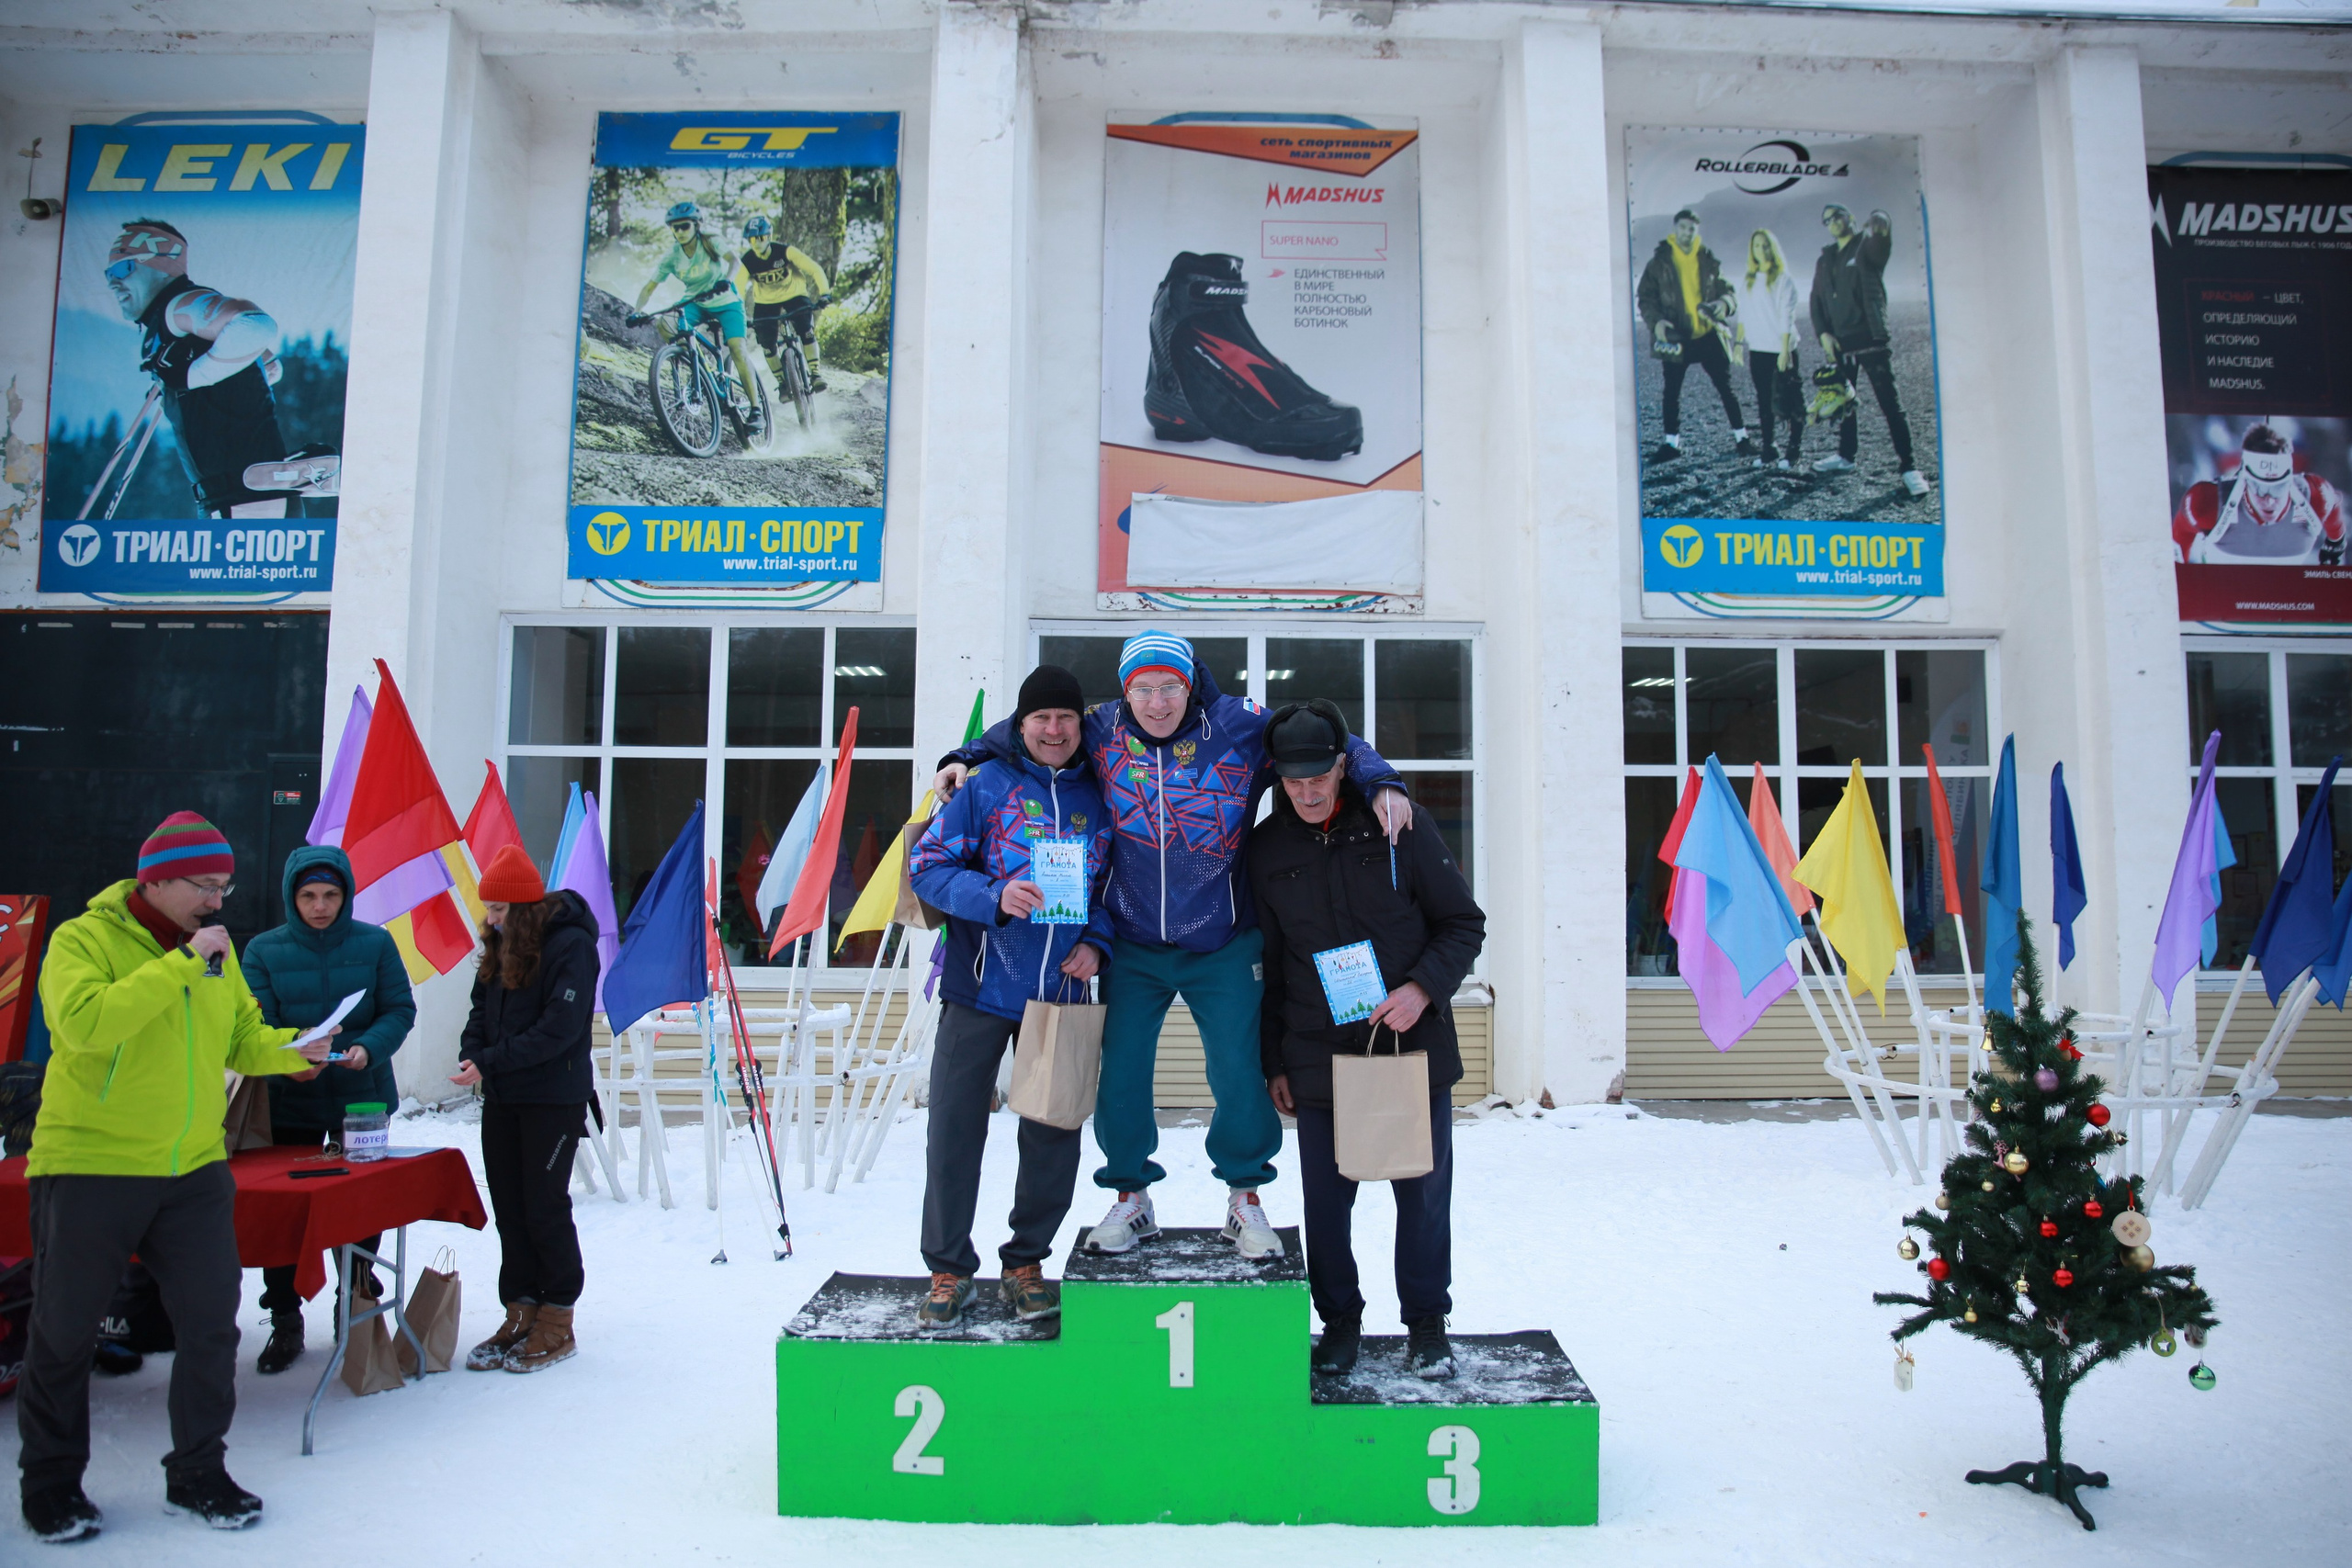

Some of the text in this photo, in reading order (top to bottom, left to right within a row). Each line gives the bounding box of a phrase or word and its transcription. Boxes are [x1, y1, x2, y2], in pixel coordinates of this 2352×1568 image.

[670, 127, 839, 150] GT
[1261, 138, 1393, 150] сеть спортивных
[1290, 150, 1372, 160] магазинов
[86, 142, 351, 193] LEKI
[1695, 158, 1831, 175] ROLLERBLADE
[1283, 186, 1385, 204] MADSHUS
[2177, 202, 2352, 236] MADSHUS
[1270, 235, 1340, 246] SUPER NANO
[1295, 268, 1385, 280] ЕДИНСТВЕННЫЙ
[1295, 281, 1335, 291] В МИРЕ
[1295, 293, 1366, 304] ПОЛНОСТЬЮ
[1295, 305, 1373, 316] КАРБОНОВЫЙ
[1295, 318, 1349, 328] БОТИНОК
[2203, 311, 2297, 325] ОПРЕДЕЛЯЮЩИЙ
[2205, 333, 2260, 345] ИСТОРИЮ
[2207, 355, 2275, 368] И НАСЛЕДИЕ
[2209, 377, 2266, 389] MADSHUS.
[723, 556, 858, 573] www.trial-sport.ru
[189, 565, 318, 581] www.trial-sport.ru
[1796, 570, 1922, 587] www.trial-sport.ru
[2332, 570, 2352, 580] СВЕН
[2235, 602, 2314, 610] WWW.MADSHUS.COM
[1329, 962, 1367, 976] ГРАМОТА
[546, 1134, 567, 1171] noname
[1155, 1301, 1193, 1388] 1
[893, 1385, 944, 1476] 2
[1426, 1425, 1480, 1515] 3
